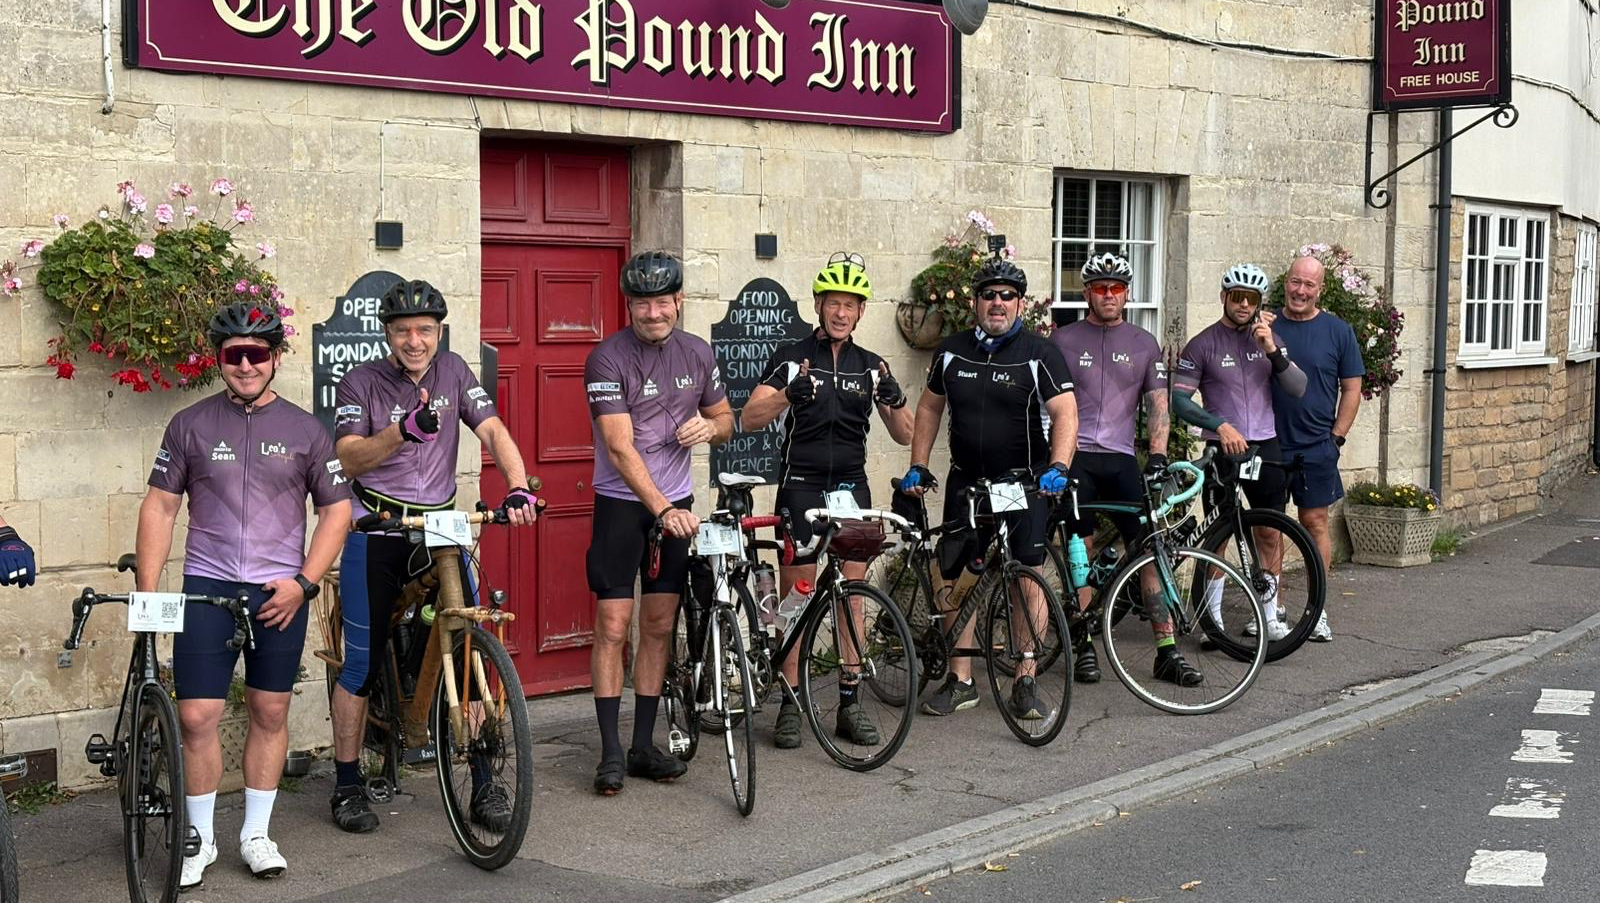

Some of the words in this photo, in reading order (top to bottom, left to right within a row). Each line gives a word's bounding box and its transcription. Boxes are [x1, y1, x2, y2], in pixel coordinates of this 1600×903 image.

[1394, 0, 1485, 32] Pound
[570, 0, 786, 86] Pound
[807, 11, 918, 98] Inn
[1412, 37, 1467, 67] Inn
[1400, 74, 1431, 88] FREE
[1436, 71, 1480, 85] HOUSE
[742, 291, 779, 307] FOOD
[730, 308, 793, 325] OPENING
[743, 324, 787, 337] TIMES
[957, 370, 978, 379] Stuart
[644, 388, 659, 396] Ben
[211, 452, 236, 461] Sean
[261, 442, 286, 456] Leo's
